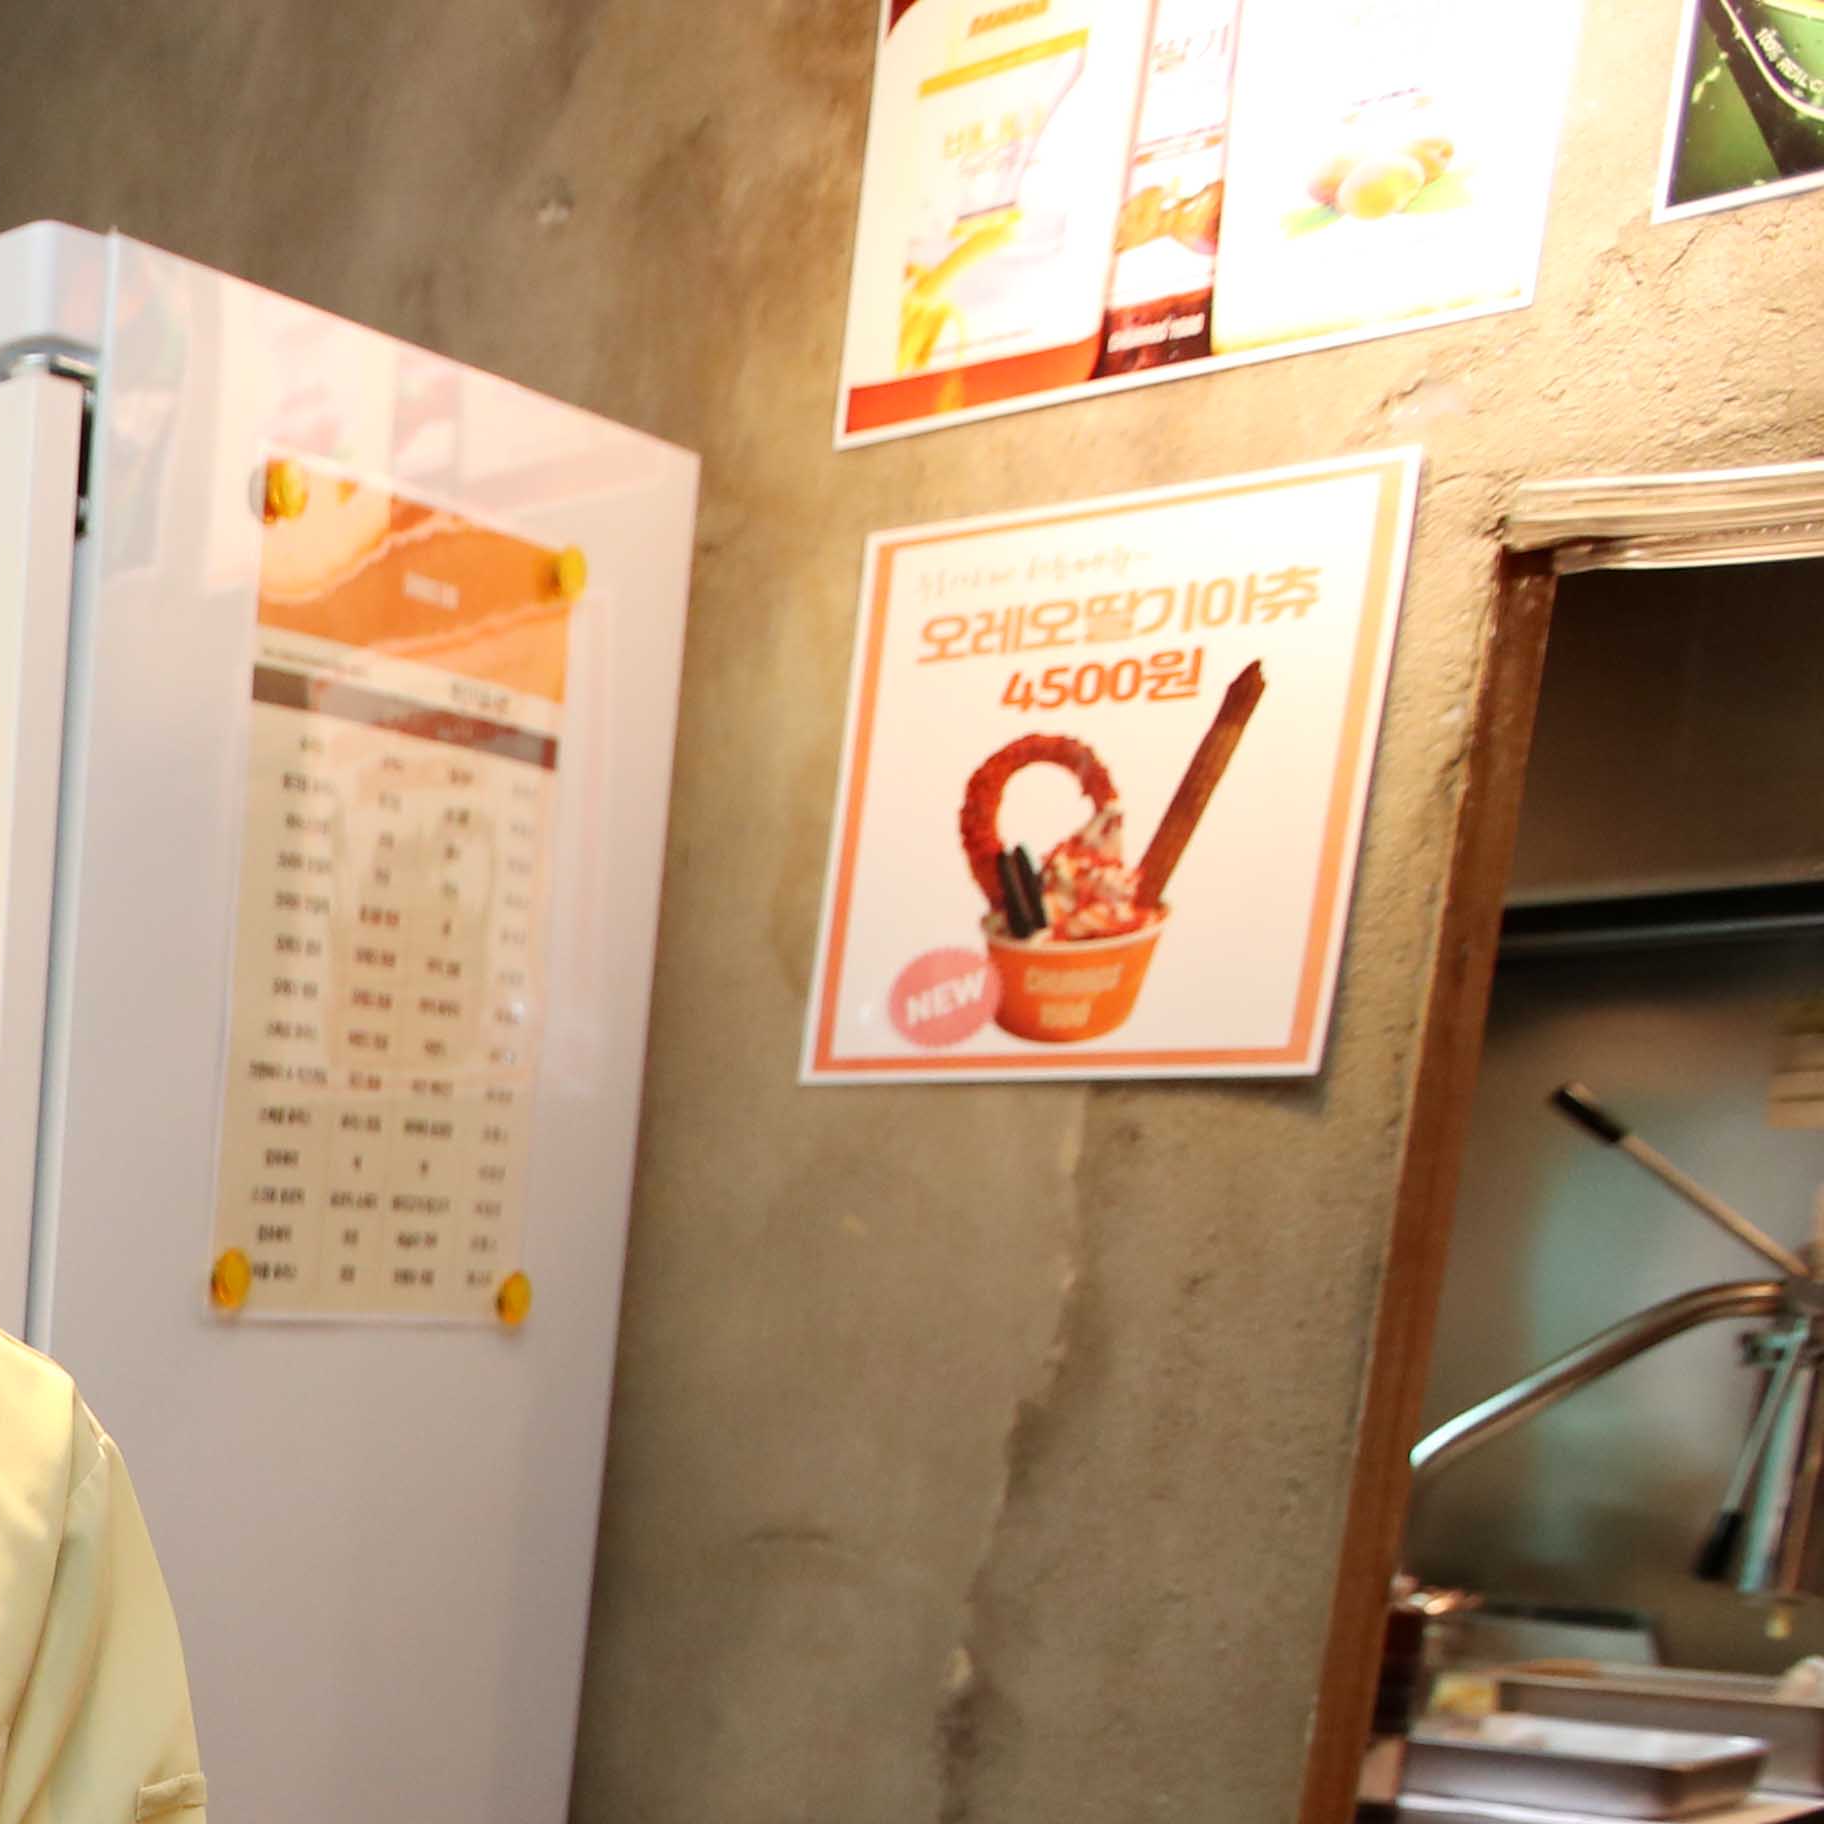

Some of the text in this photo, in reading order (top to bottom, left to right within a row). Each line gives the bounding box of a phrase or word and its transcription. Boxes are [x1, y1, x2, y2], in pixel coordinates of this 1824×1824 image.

[916, 565, 1322, 666] 오레오딸기아츄
[1000, 646, 1204, 714] 4500원
[906, 968, 988, 1028] NEW
